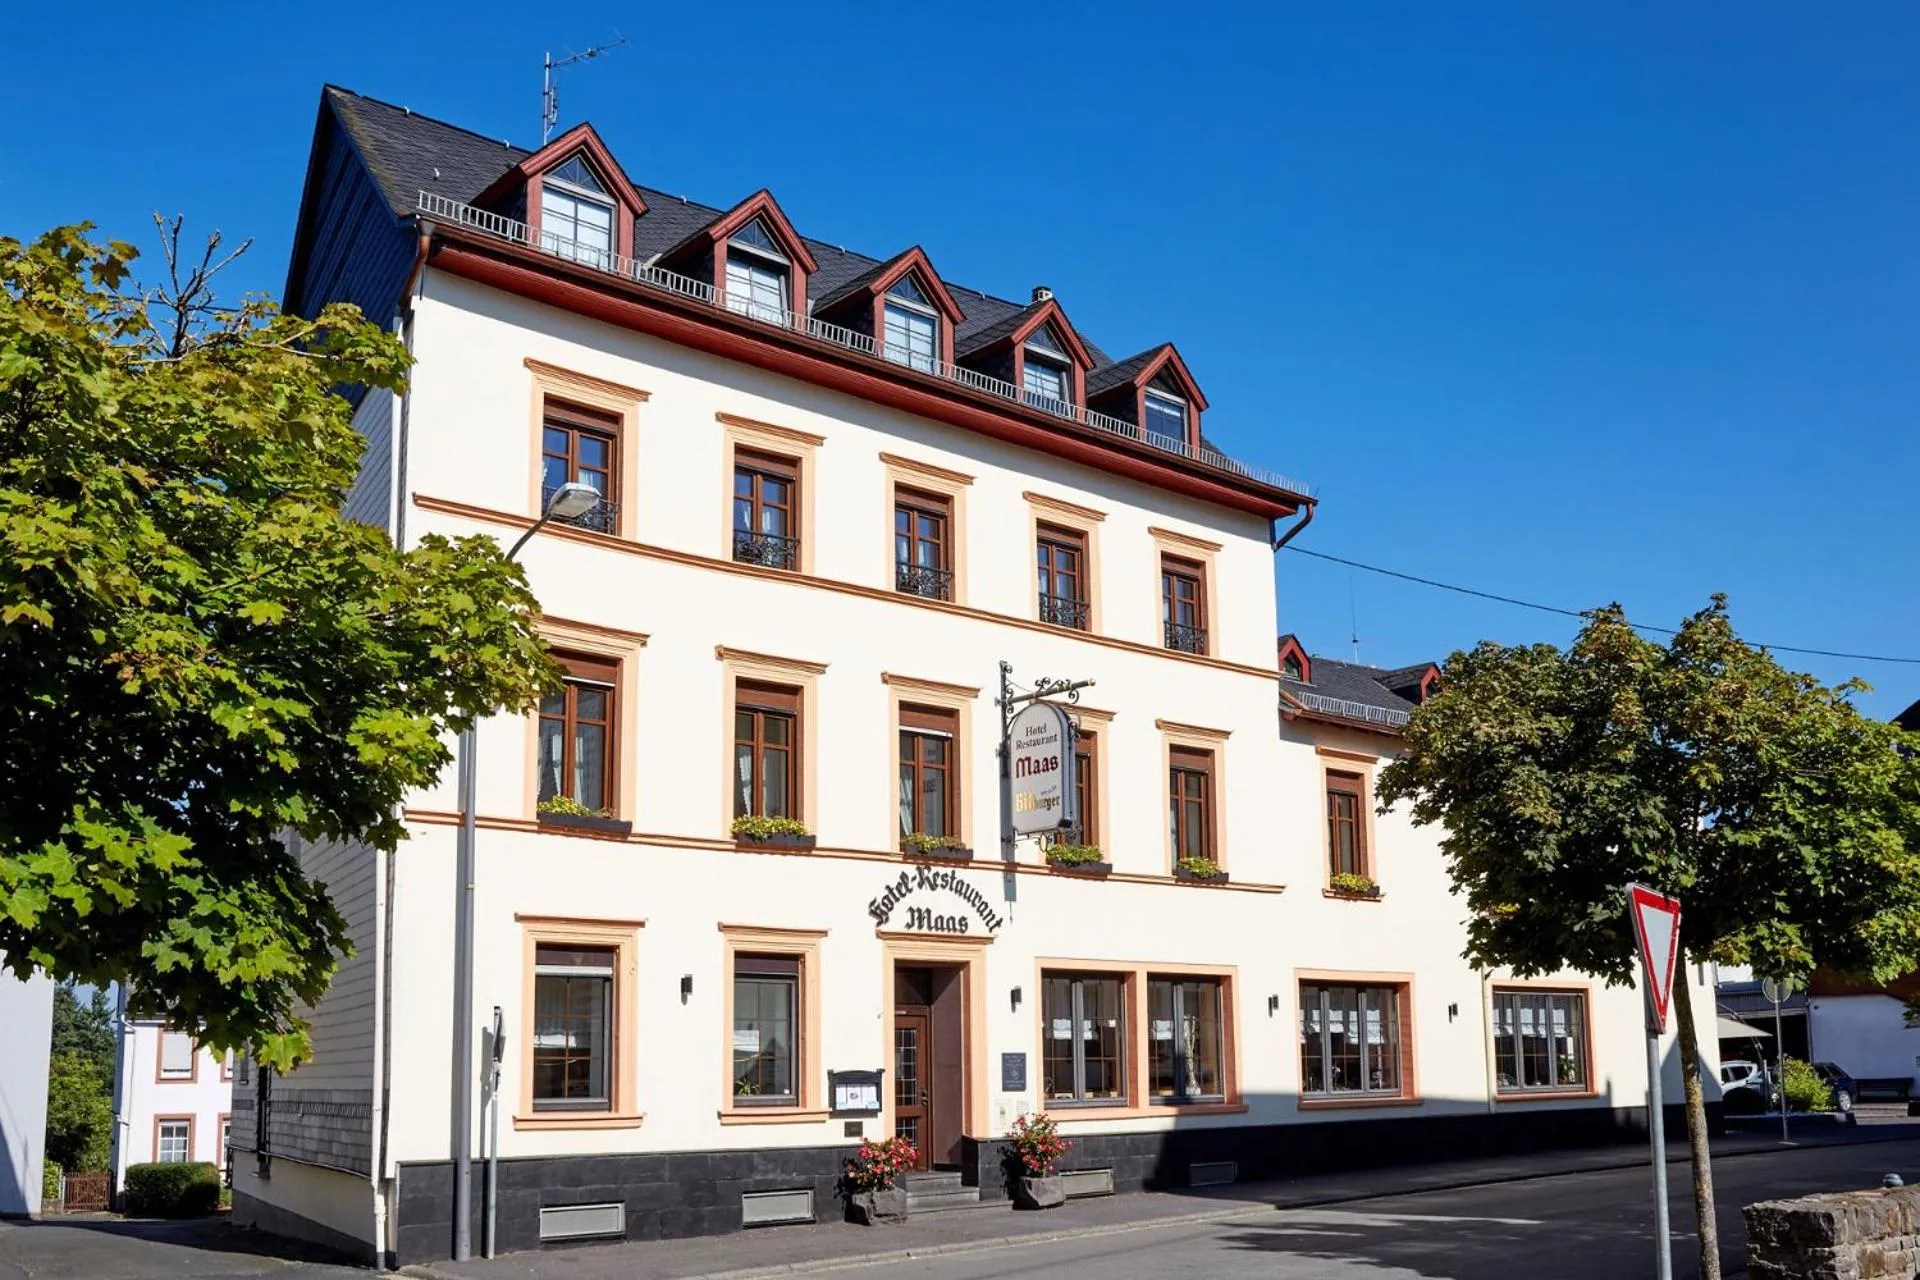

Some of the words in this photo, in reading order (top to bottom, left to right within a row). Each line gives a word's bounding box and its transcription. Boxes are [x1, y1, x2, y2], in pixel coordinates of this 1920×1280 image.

[1025, 722, 1047, 737] Hotel
[1016, 733, 1058, 750] Restaurant
[1016, 756, 1059, 778] Maas
[904, 905, 969, 933] Maas
